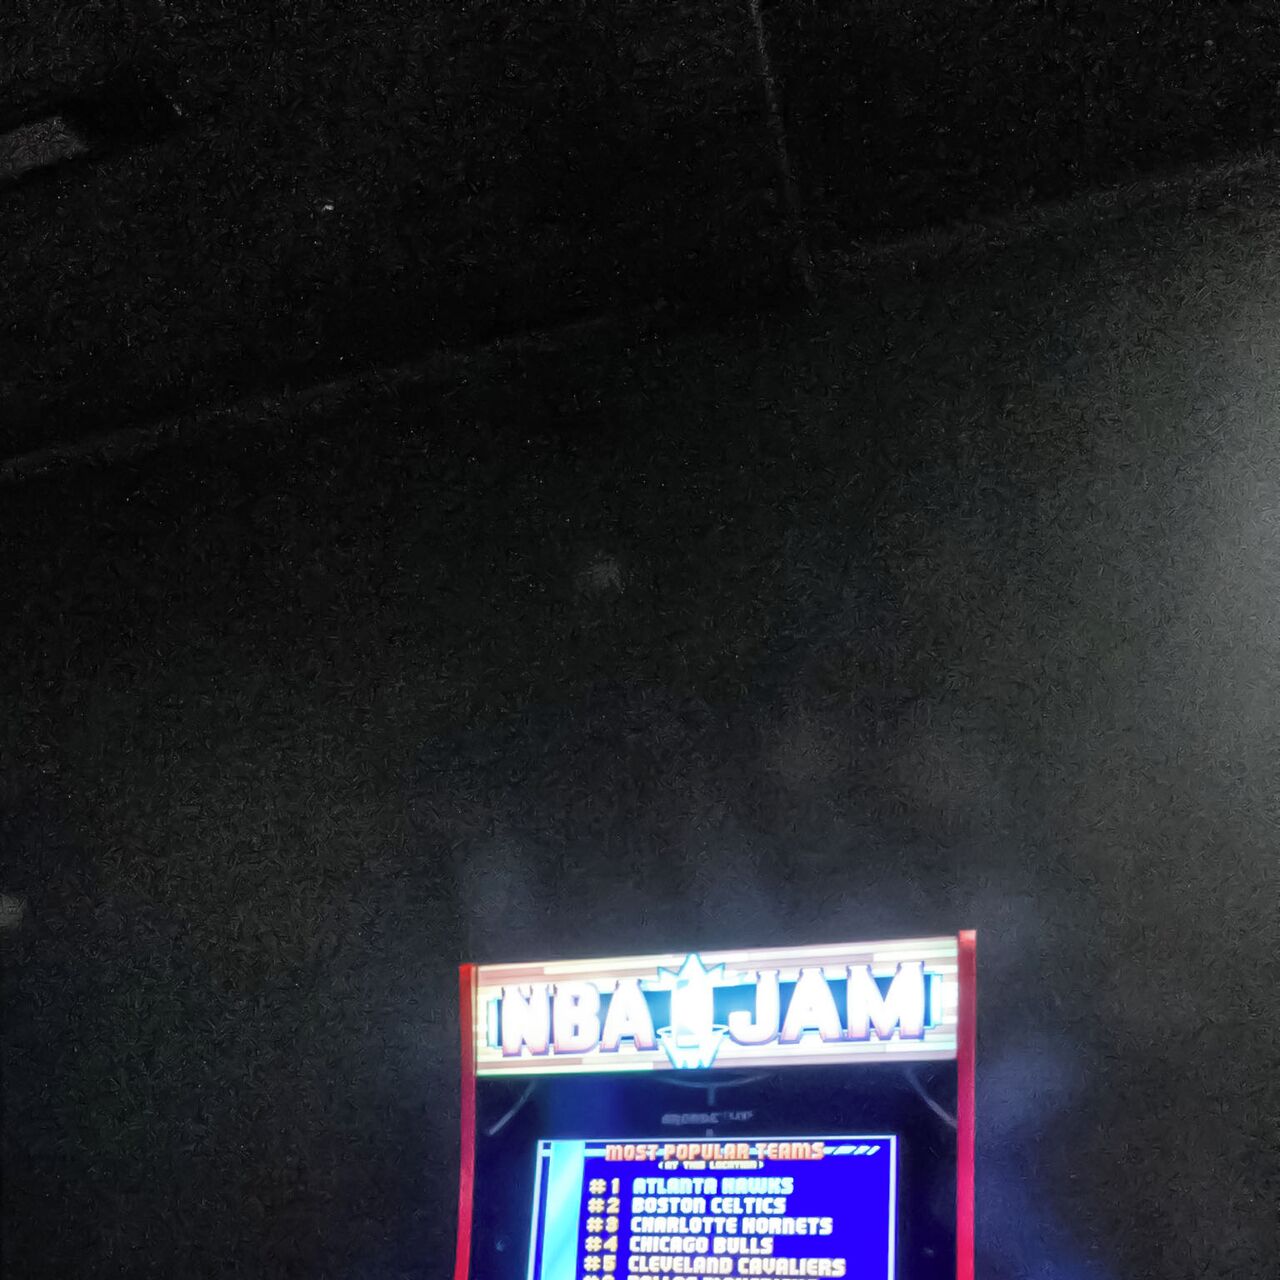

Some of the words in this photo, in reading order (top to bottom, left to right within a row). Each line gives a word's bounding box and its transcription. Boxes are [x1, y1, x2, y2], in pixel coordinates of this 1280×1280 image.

[502, 979, 658, 1057] NBA
[728, 961, 926, 1046] JAM
[605, 1144, 658, 1161] MOST
[663, 1143, 749, 1160] POPULAR
[755, 1142, 824, 1160] TEAMS
[632, 1177, 718, 1194] ATLANTA
[721, 1177, 794, 1194] HAWKS
[631, 1197, 706, 1213] BOSTON
[710, 1197, 786, 1214] CELTICS
[630, 1216, 738, 1234] CHARLOTTE
[742, 1217, 833, 1235] HORNETS
[629, 1236, 709, 1253] CHICAGO
[713, 1237, 774, 1254] BULLS
[627, 1255, 733, 1274] CLEVELAND
[737, 1258, 846, 1277] CAVALIERS
